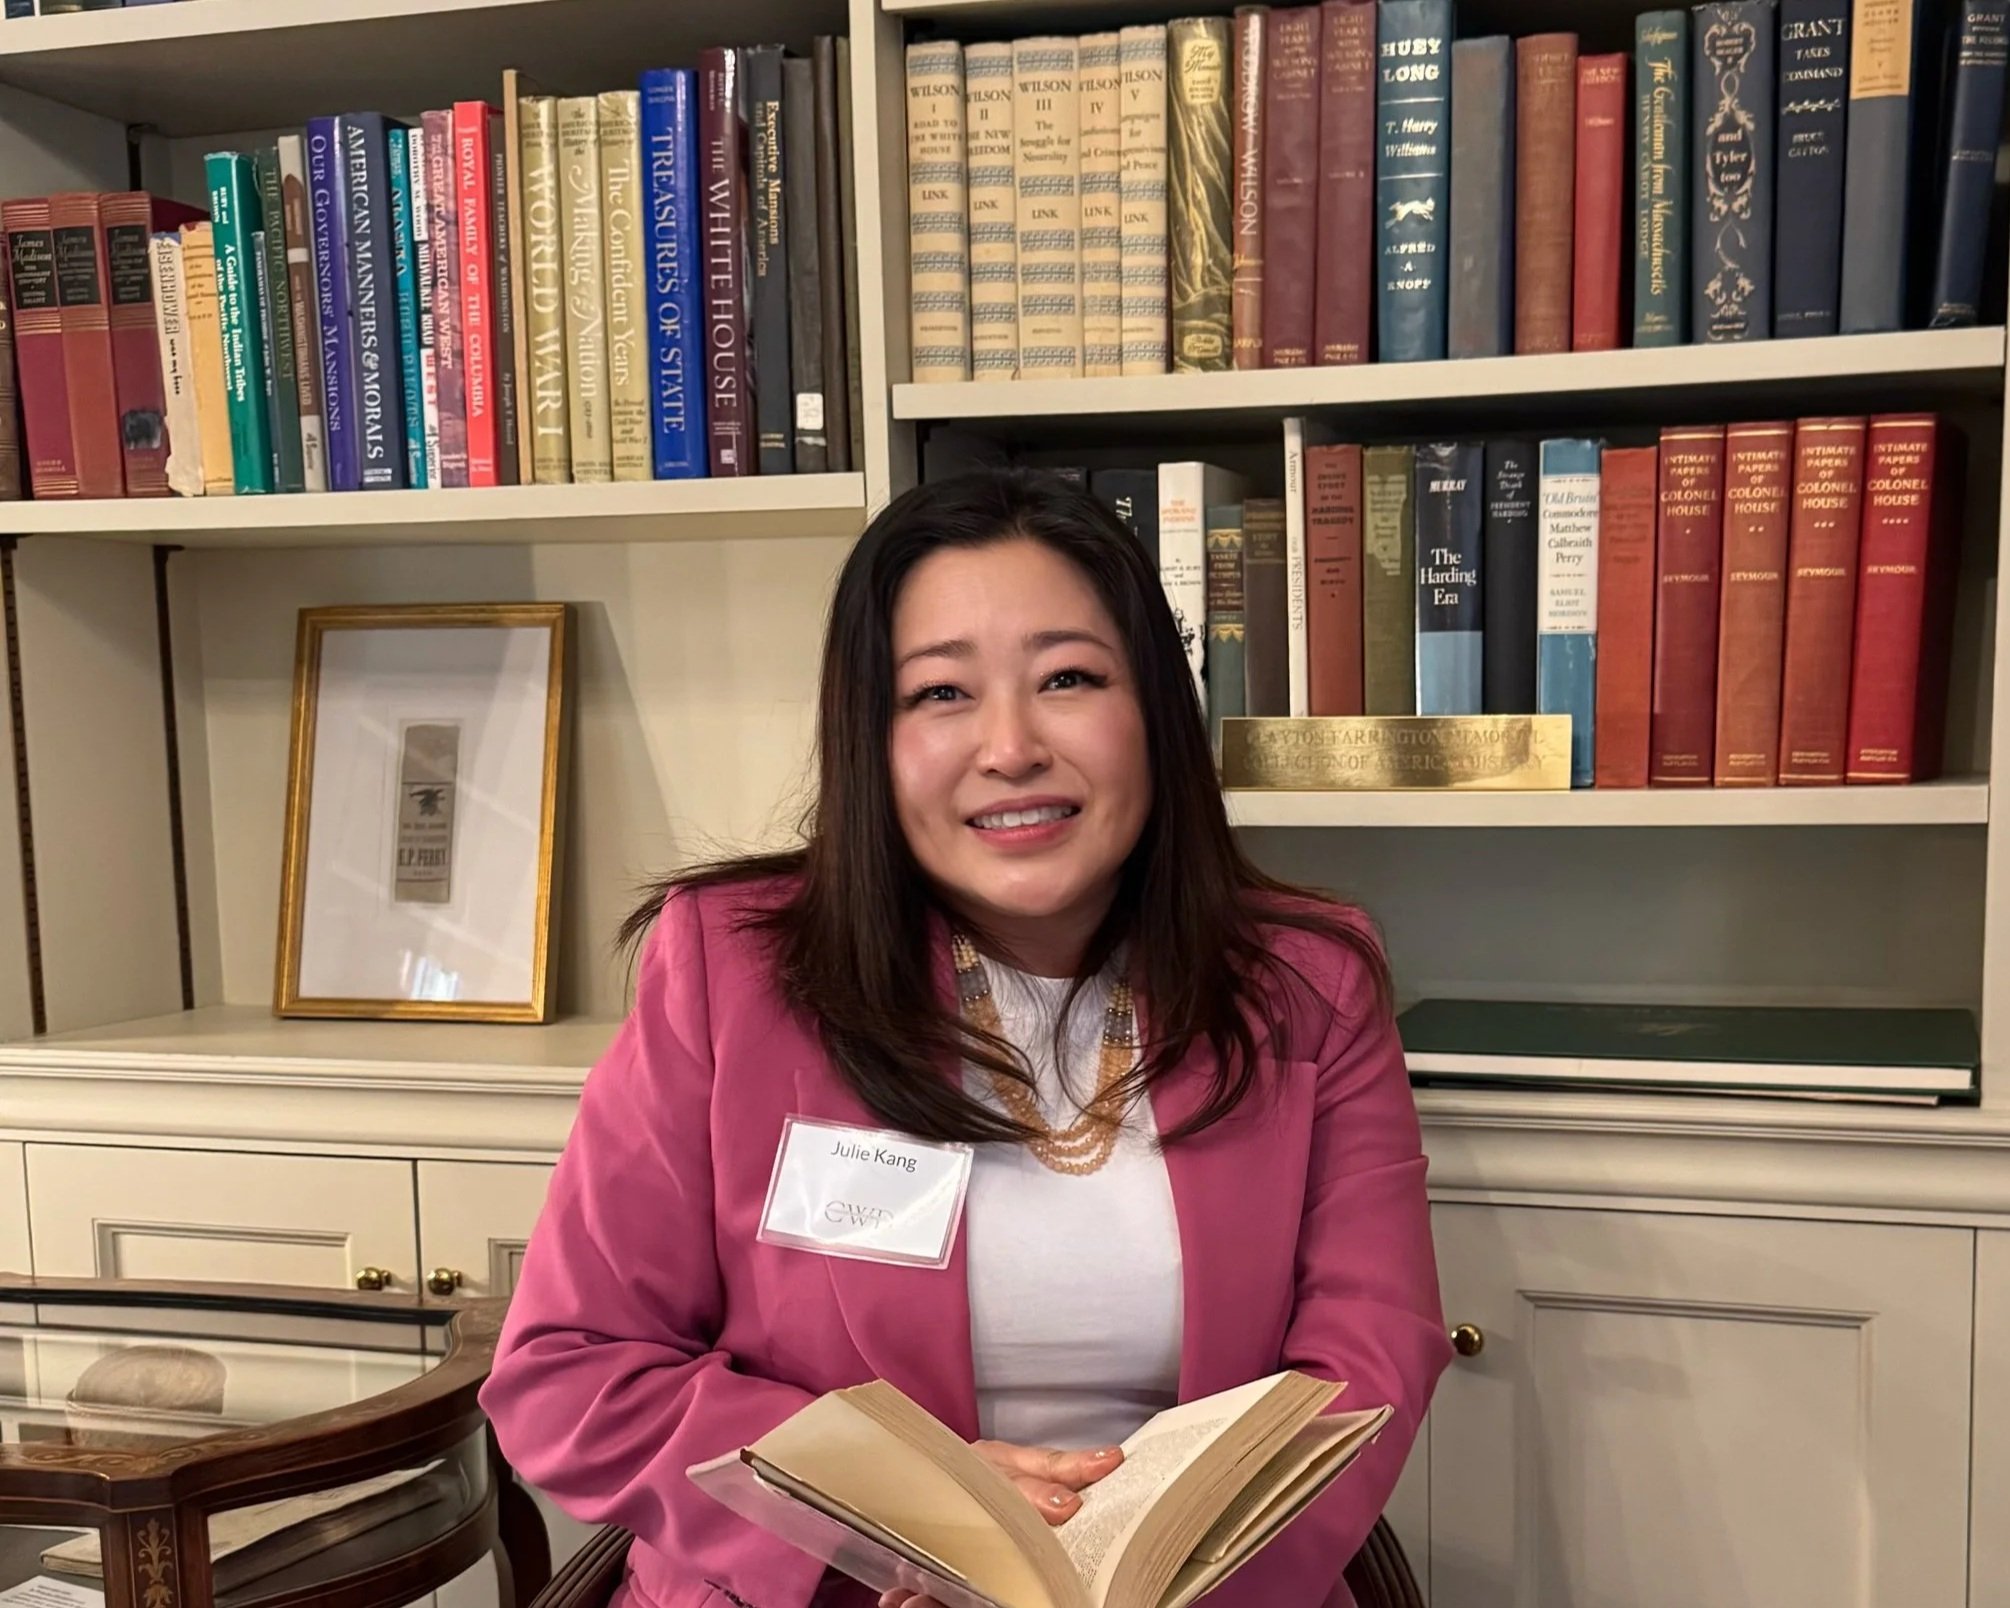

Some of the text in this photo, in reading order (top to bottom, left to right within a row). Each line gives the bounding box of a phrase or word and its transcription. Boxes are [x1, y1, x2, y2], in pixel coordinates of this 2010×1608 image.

[1781, 18, 1844, 40] GRANT
[1795, 46, 1831, 60] TAKES
[1383, 63, 1440, 82] LONG
[1646, 57, 1677, 84] The
[1784, 67, 1844, 82] COMMAND
[910, 84, 961, 98] WILSON
[1018, 80, 1072, 93] WILSON
[1130, 90, 1140, 101] V
[1036, 98, 1052, 111] III
[1090, 102, 1104, 114] IV
[980, 108, 988, 121] II
[1385, 118, 1438, 135] T. Harry
[1385, 141, 1437, 157] Williams
[1712, 150, 1747, 169] Tyler
[347, 125, 371, 234] AMERICAN
[766, 101, 782, 245] Executive Mansions
[1651, 163, 1676, 195] from
[263, 167, 279, 201] THE
[922, 189, 950, 201] LINK
[1239, 148, 1258, 235] WILSON
[651, 126, 679, 294] TREASURES
[974, 199, 999, 211] LINK
[1032, 209, 1059, 220] LINK
[1084, 207, 1113, 218] LINK
[1124, 213, 1149, 224] LINK
[529, 163, 560, 314] WORLD
[709, 178, 733, 289] WHITE
[16, 235, 45, 249] James
[268, 210, 286, 272] PACIFIC
[1385, 241, 1435, 255] ALFRED
[12, 247, 53, 264] Madison
[432, 156, 454, 369] GREAT AMERICAN WEST
[417, 243, 433, 310] MILWAUKEE
[461, 137, 484, 417] ROYAL FAMILY OF THE COLUMBIA
[608, 159, 636, 386] The Confident Years
[156, 240, 180, 335] EISENHOWER
[312, 135, 342, 432] OUR GOVERNORS' MANSIONS
[1387, 278, 1432, 291] KNOPF
[225, 243, 247, 403] A Guide to the Indian Tribes
[659, 302, 682, 339] OF
[275, 279, 294, 382] NORTHWEST
[571, 297, 602, 398] Nation
[712, 299, 738, 408] HOUSE
[221, 333, 233, 391] Northwest
[535, 326, 563, 415] WAR
[660, 347, 686, 434] STATE
[537, 425, 564, 437] I
[1801, 445, 1856, 457] INTIMATE
[1873, 442, 1928, 454] INTIMATE
[1664, 453, 1717, 465] INTIMATE
[1732, 450, 1786, 462] INTIMATE
[1806, 458, 1849, 468] PAPERS
[1877, 455, 1921, 465] PAPERS
[1289, 450, 1299, 493] Armour
[1669, 466, 1711, 476] PAPERS
[1737, 463, 1780, 474] PAPERS
[1818, 469, 1835, 479] OF
[1890, 466, 1906, 477] OF
[1429, 479, 1468, 493] MURRAY
[1681, 477, 1696, 488] OF
[1750, 474, 1765, 485] OF
[1867, 478, 1929, 492] COLONEL
[1727, 486, 1786, 500] COLONEL
[1796, 481, 1857, 495] COLONEL
[1660, 489, 1716, 503] COLONEL
[1873, 494, 1920, 507] HOUSE
[1666, 504, 1711, 517] HOUSE
[1734, 501, 1780, 514] HOUSE
[1802, 497, 1849, 510] HOUSE
[1542, 508, 1599, 520] Commodore
[1550, 523, 1592, 534] Matthew
[1547, 536, 1593, 550] Calbraith
[1430, 547, 1462, 566] The
[1555, 552, 1583, 567] Perry
[1420, 567, 1477, 587] Harding
[1291, 555, 1304, 631] PRESIDENTS
[1433, 588, 1459, 606] Era
[831, 1141, 918, 1173] Julie Kang
